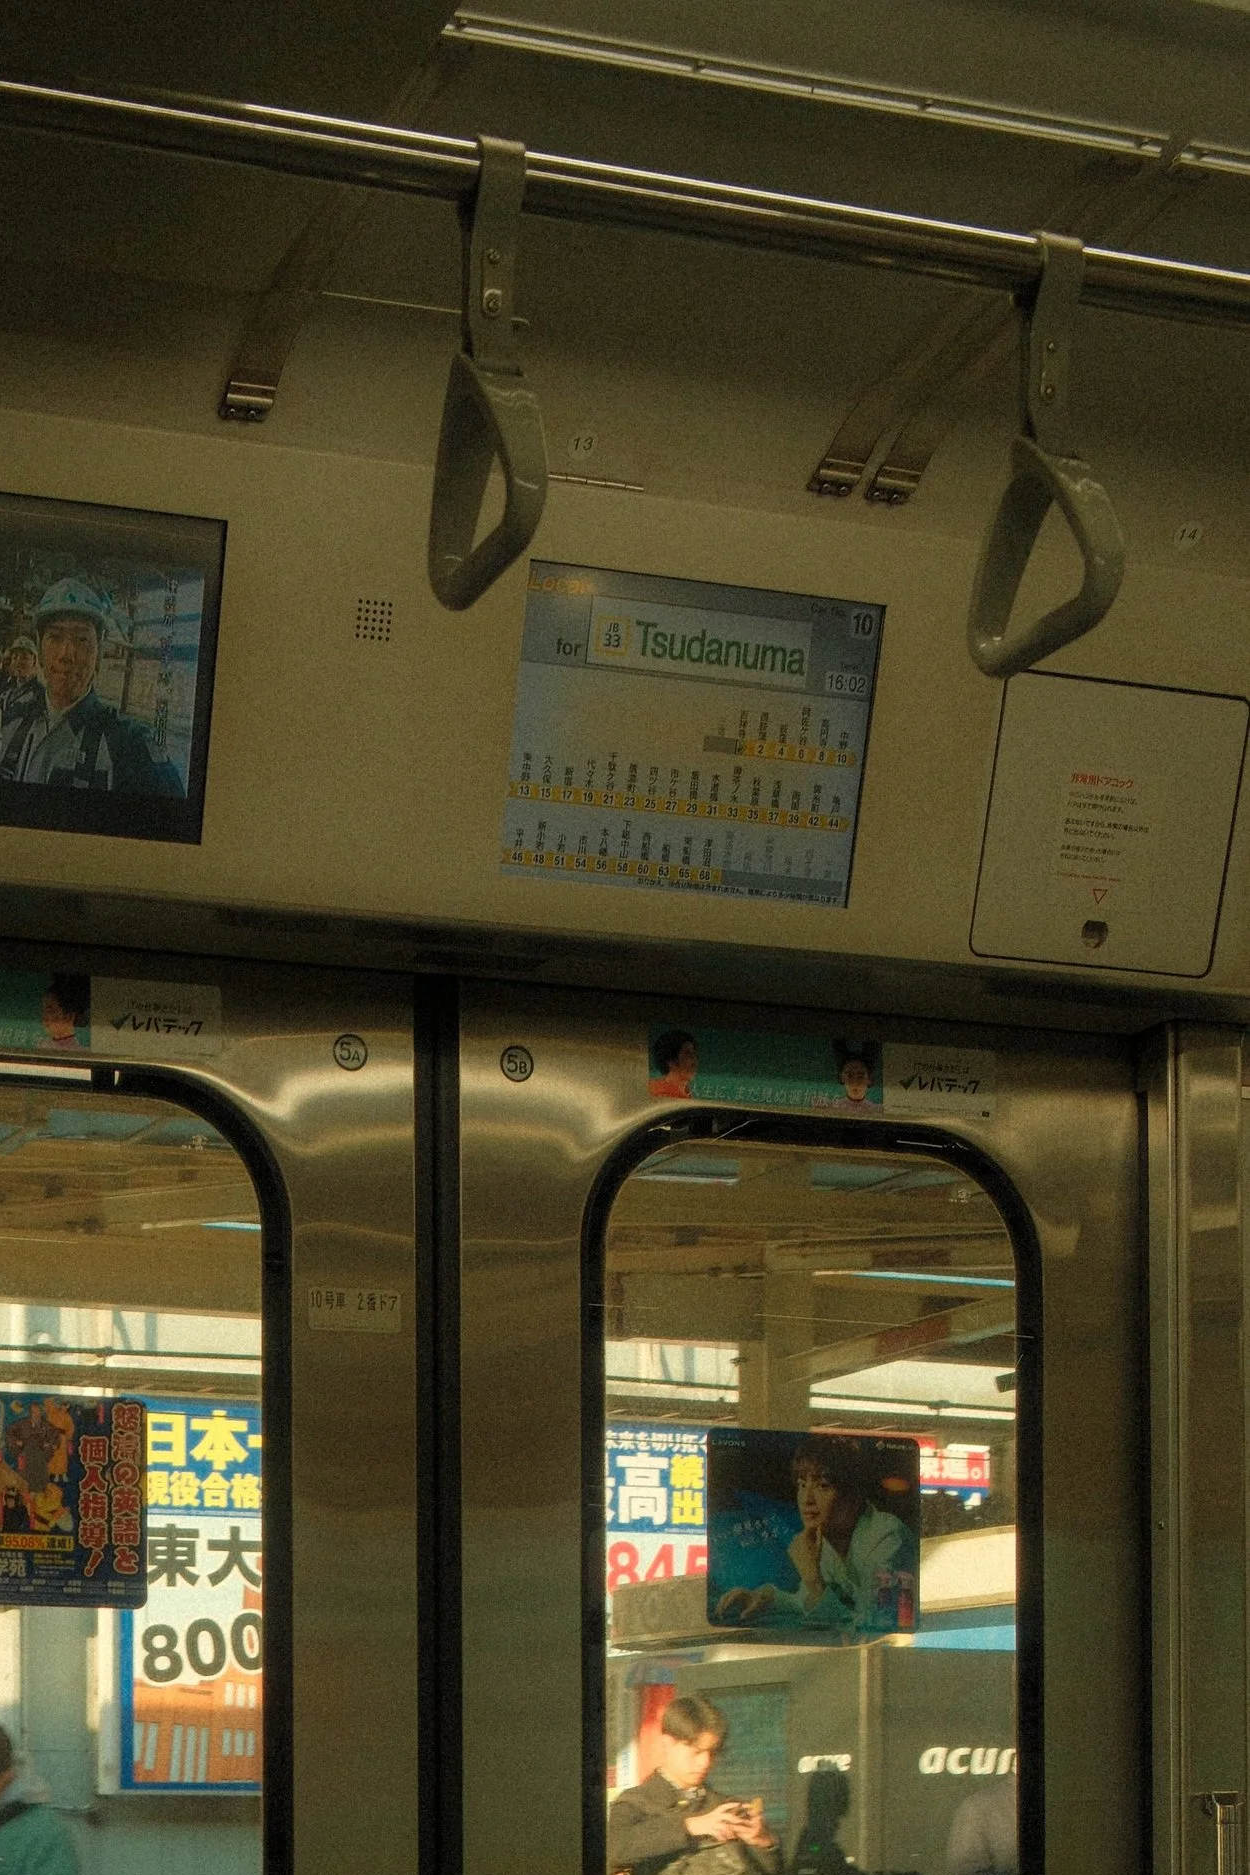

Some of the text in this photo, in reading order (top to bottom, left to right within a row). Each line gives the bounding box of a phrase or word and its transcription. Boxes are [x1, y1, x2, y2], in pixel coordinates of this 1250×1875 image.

[573, 436, 593, 451] 13
[1180, 528, 1198, 541] 14
[607, 621, 619, 633] JB
[853, 612, 873, 635] 10
[556, 637, 581, 656] for
[602, 632, 620, 648] 33
[636, 620, 806, 676] Tsudanuma
[828, 673, 866, 693] 16:02
[758, 745, 764, 754] 2
[799, 750, 804, 759] 6
[819, 752, 824, 761] 8
[838, 754, 847, 763] 10
[519, 786, 839, 828] 13 15 17 19 21 23 25 27 29 31 33 35 37 39 42 44
[511, 852, 523, 862] 46
[533, 854, 544, 864] 48
[554, 856, 565, 866] 51
[575, 858, 586, 868] 54
[596, 860, 607, 870] 56
[617, 862, 628, 872] 58
[637, 864, 649, 874] 60
[658, 866, 669, 876] 63
[700, 871, 711, 881] 68
[132, 1015, 204, 1036] レバテック
[338, 1041, 361, 1063] 5A
[507, 1054, 528, 1075] 5B
[918, 1076, 980, 1094] レバテック
[311, 1290, 397, 1311] 10号車 2番ドア
